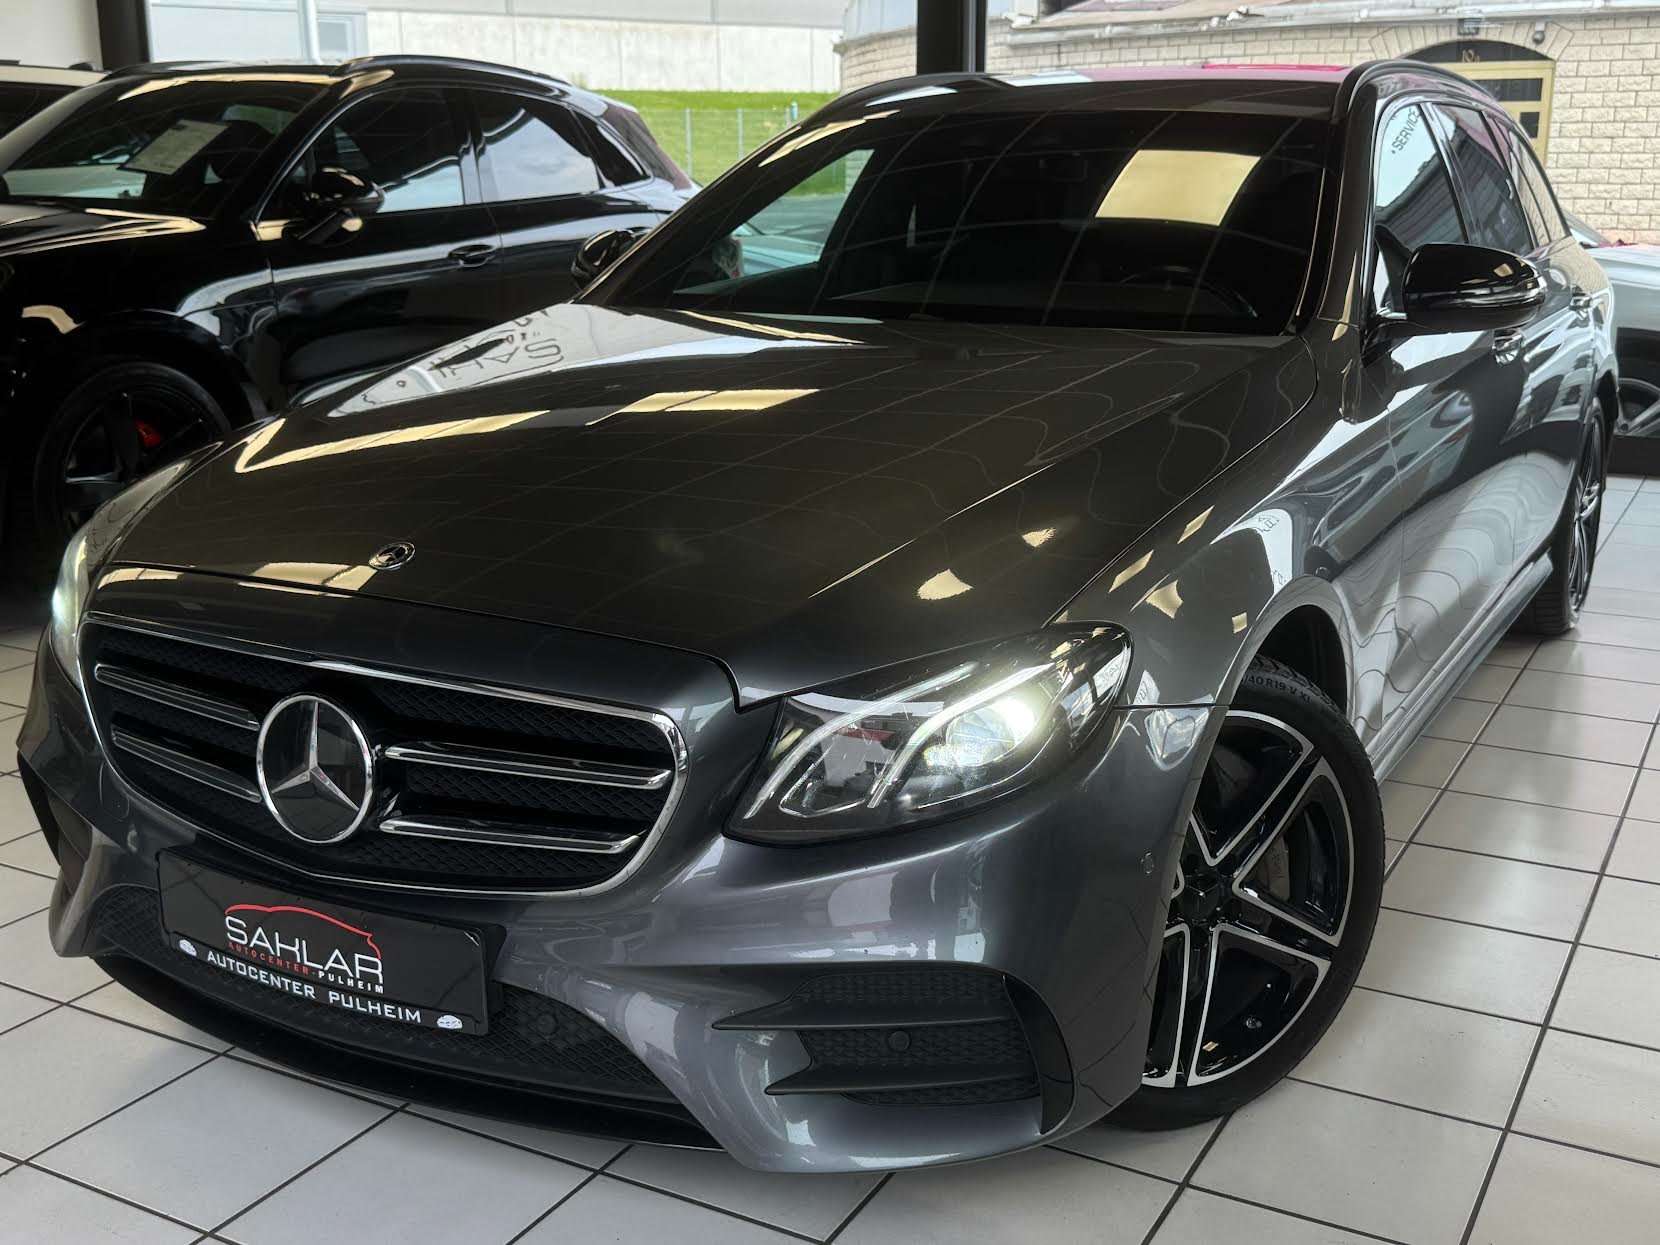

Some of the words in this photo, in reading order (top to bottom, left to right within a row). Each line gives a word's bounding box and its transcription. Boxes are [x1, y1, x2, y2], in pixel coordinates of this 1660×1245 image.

[225, 915, 384, 983] SAHLAR
[207, 950, 316, 999] AUTOCENTER
[328, 990, 421, 1024] PULHEIM
